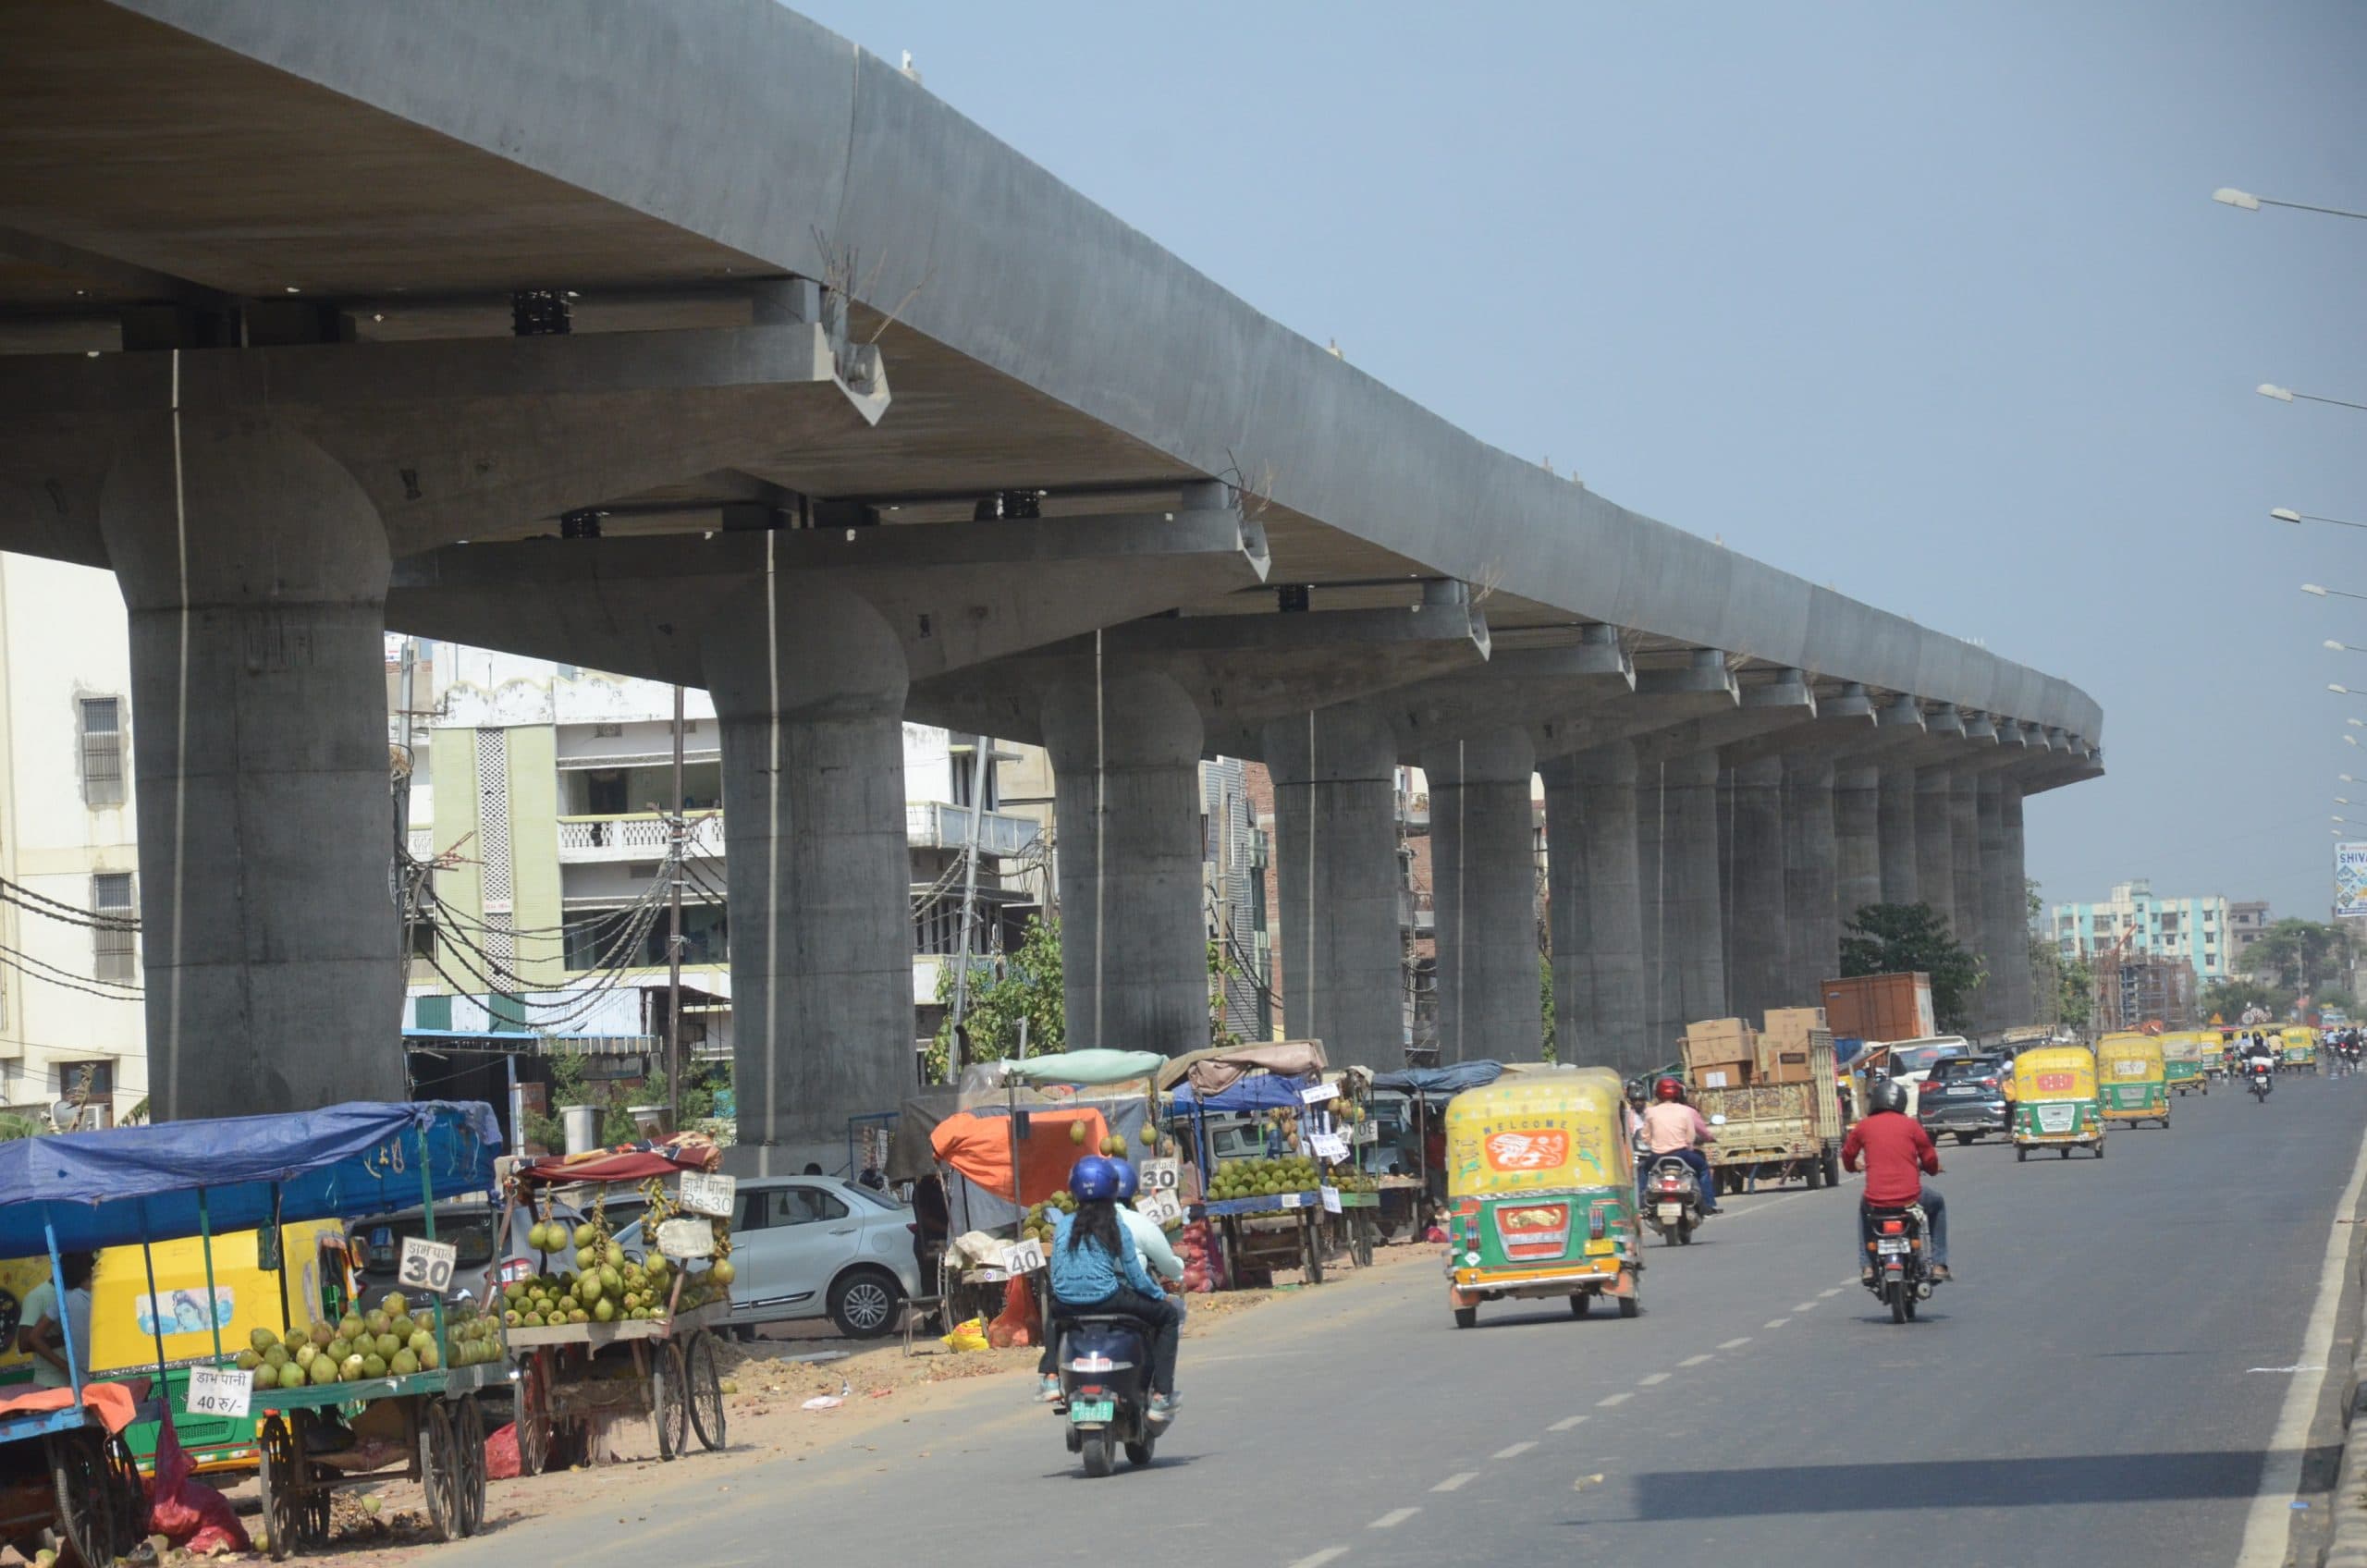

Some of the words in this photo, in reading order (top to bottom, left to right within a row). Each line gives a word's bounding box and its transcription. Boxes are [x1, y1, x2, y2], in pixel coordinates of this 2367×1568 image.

[2339, 852, 2367, 864] SHIV
[1483, 1119, 1568, 1135] WELCOME
[1143, 1170, 1175, 1188] 30
[681, 1193, 731, 1213] Rs-30
[1012, 1250, 1038, 1272] 40
[404, 1256, 450, 1287] 30
[196, 1372, 217, 1384] डाभ
[220, 1372, 246, 1386] पानी
[197, 1396, 215, 1409] 40
